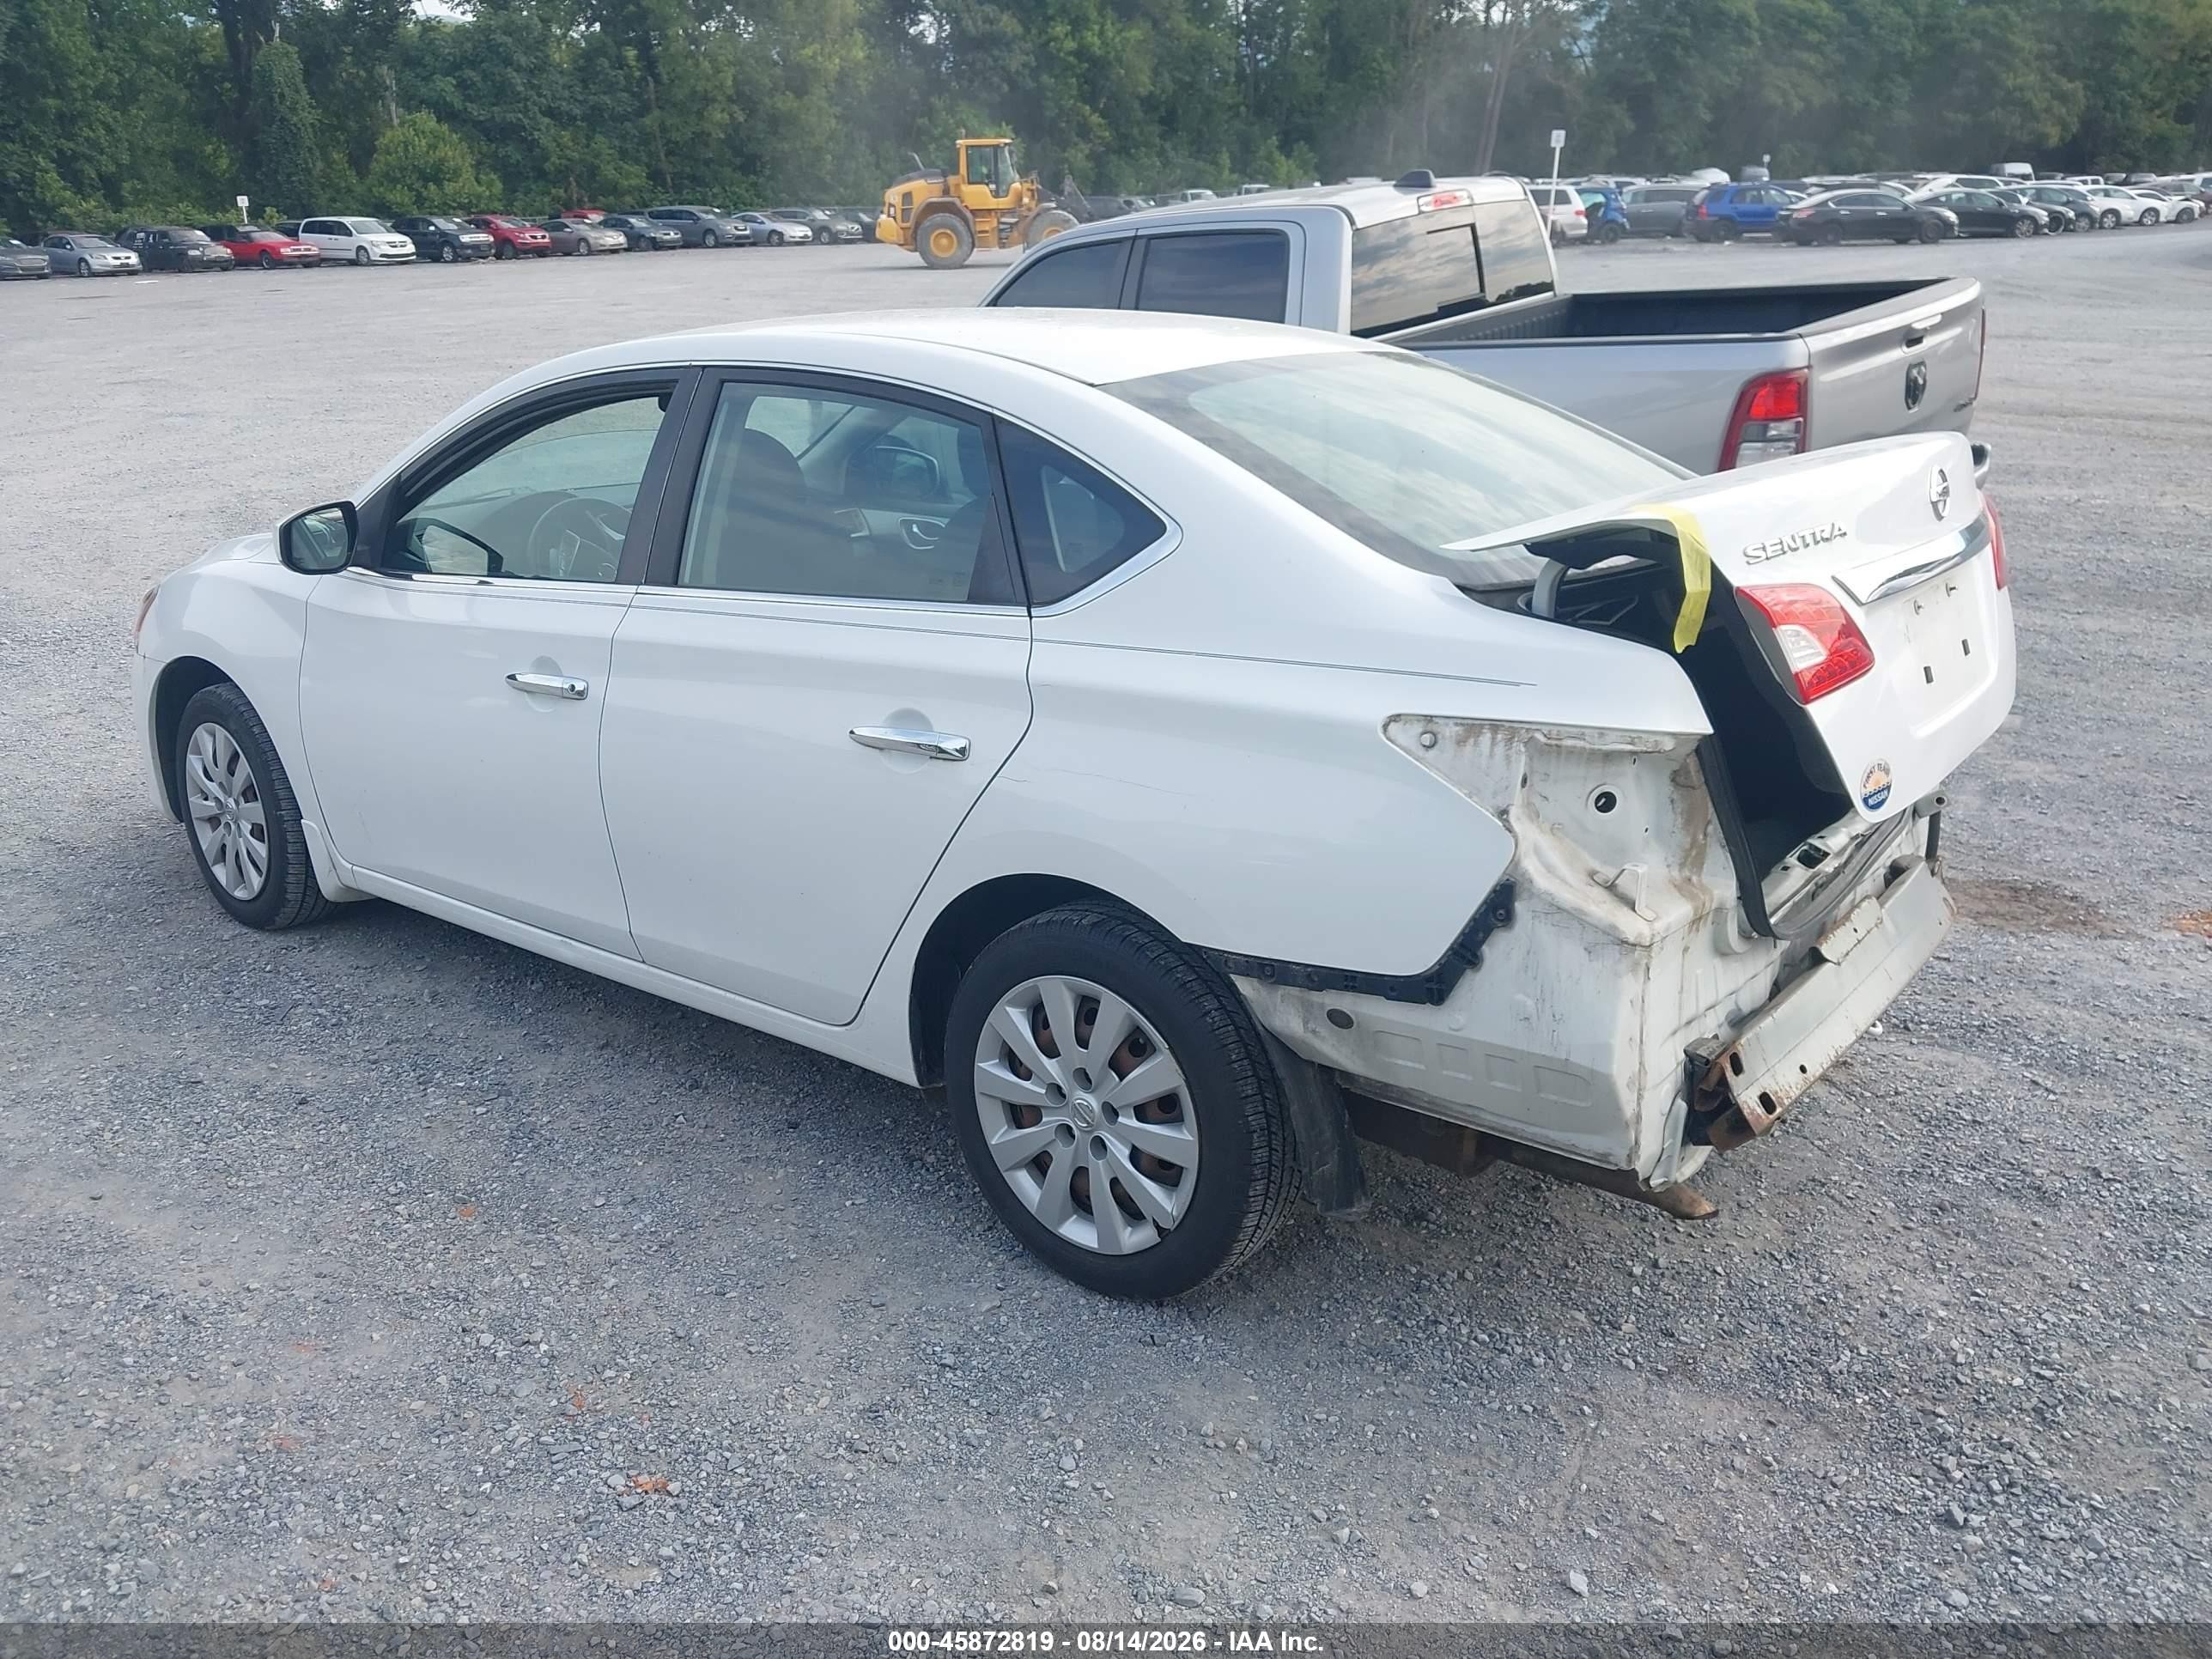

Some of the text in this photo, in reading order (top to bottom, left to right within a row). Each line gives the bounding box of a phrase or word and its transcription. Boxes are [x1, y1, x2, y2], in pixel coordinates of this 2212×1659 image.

[1742, 521, 1848, 566] SENTRA
[1863, 764, 1877, 789] FIRST
[1868, 789, 1888, 807] NISSAN
